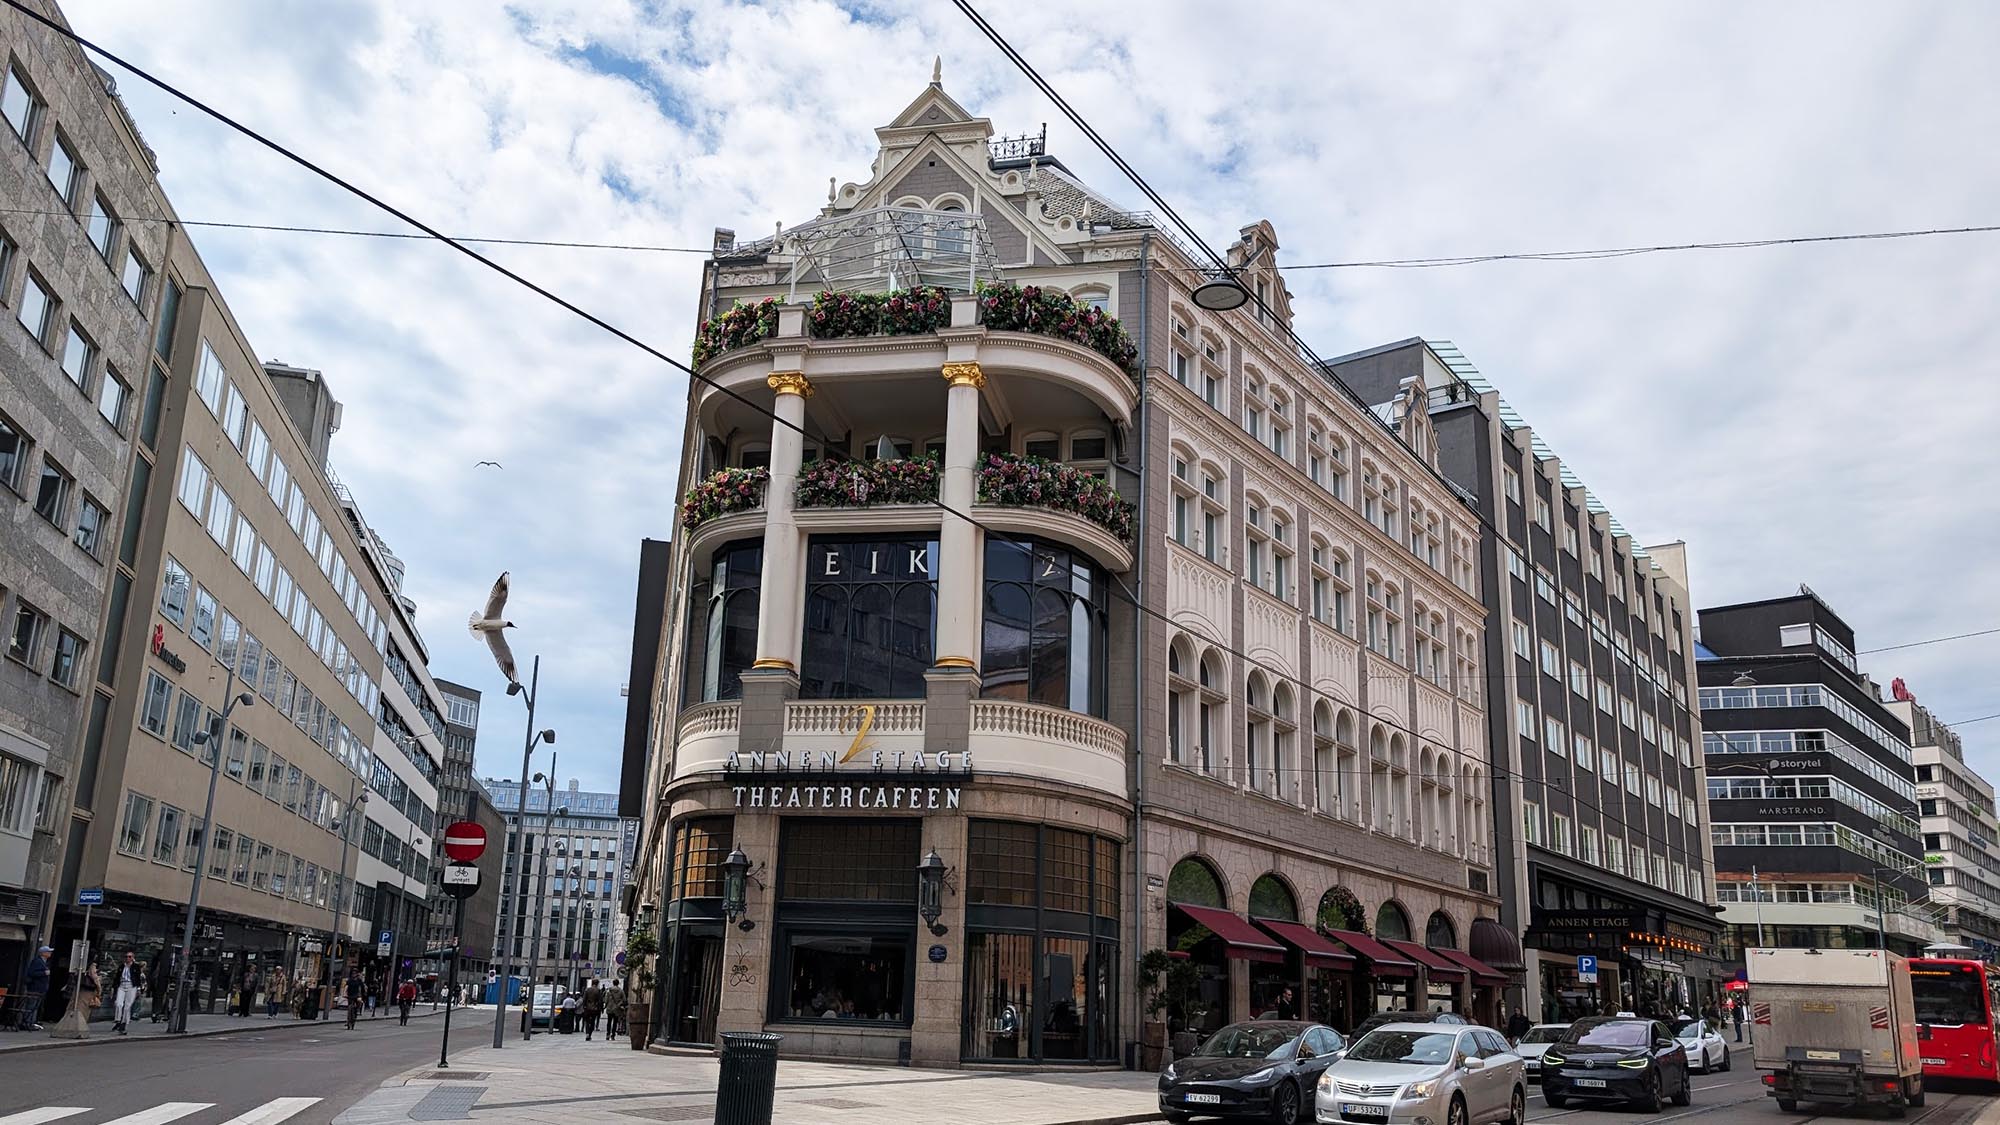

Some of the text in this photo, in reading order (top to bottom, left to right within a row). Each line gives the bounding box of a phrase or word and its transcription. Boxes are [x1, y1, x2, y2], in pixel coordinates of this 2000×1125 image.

[825, 550, 928, 576] EIK
[724, 750, 974, 768] ANNEN ETAGE
[1780, 759, 1821, 770] storytel
[732, 786, 961, 809] THEATERCAFEEN
[1548, 917, 1630, 927] ANNEN ETAGE
[1582, 958, 1592, 971] P
[1360, 1106, 1382, 1114] 53242
